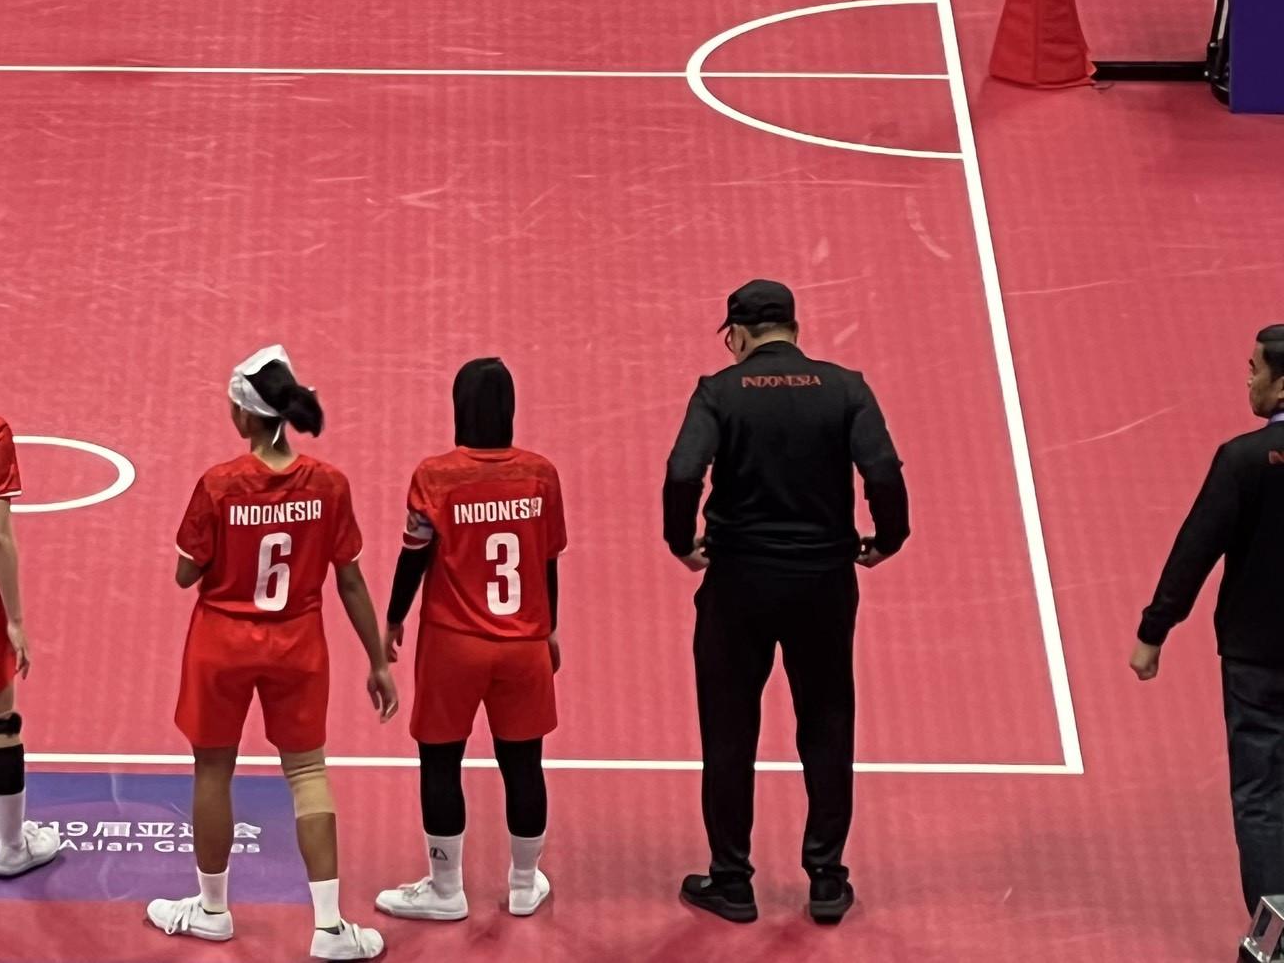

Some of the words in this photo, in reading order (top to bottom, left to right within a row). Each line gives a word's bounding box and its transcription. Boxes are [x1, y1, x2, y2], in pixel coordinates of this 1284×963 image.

[229, 499, 322, 526] INDONESIA
[253, 531, 292, 612] 6
[485, 532, 521, 616] 3
[58, 839, 144, 853] Asian
[153, 840, 261, 854] Gaes
